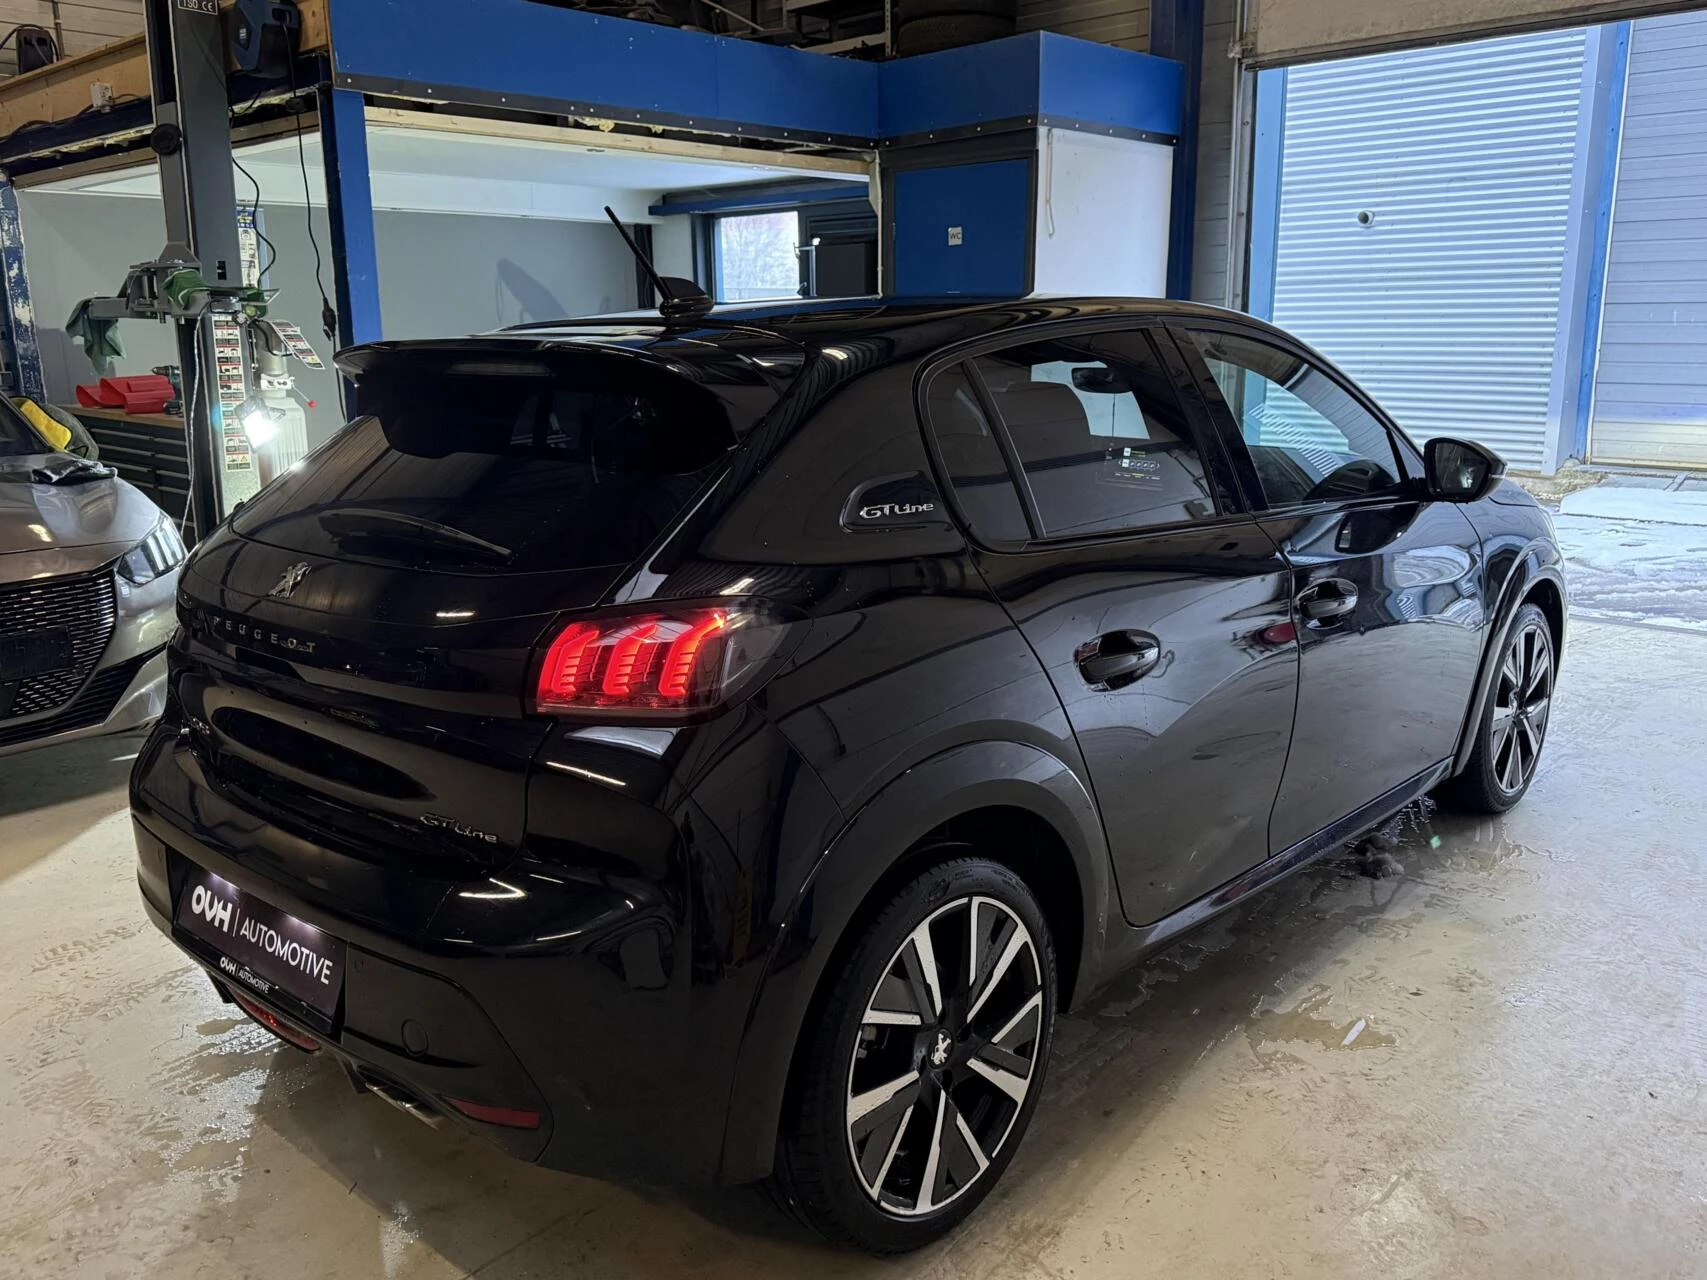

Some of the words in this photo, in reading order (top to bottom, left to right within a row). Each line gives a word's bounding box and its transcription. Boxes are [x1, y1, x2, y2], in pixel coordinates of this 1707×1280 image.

[950, 231, 961, 240] WC
[213, 615, 317, 654] PEUGEOT
[240, 917, 333, 985] AUTOMOTIVE
[239, 969, 270, 994] AUTOMOTIVE
